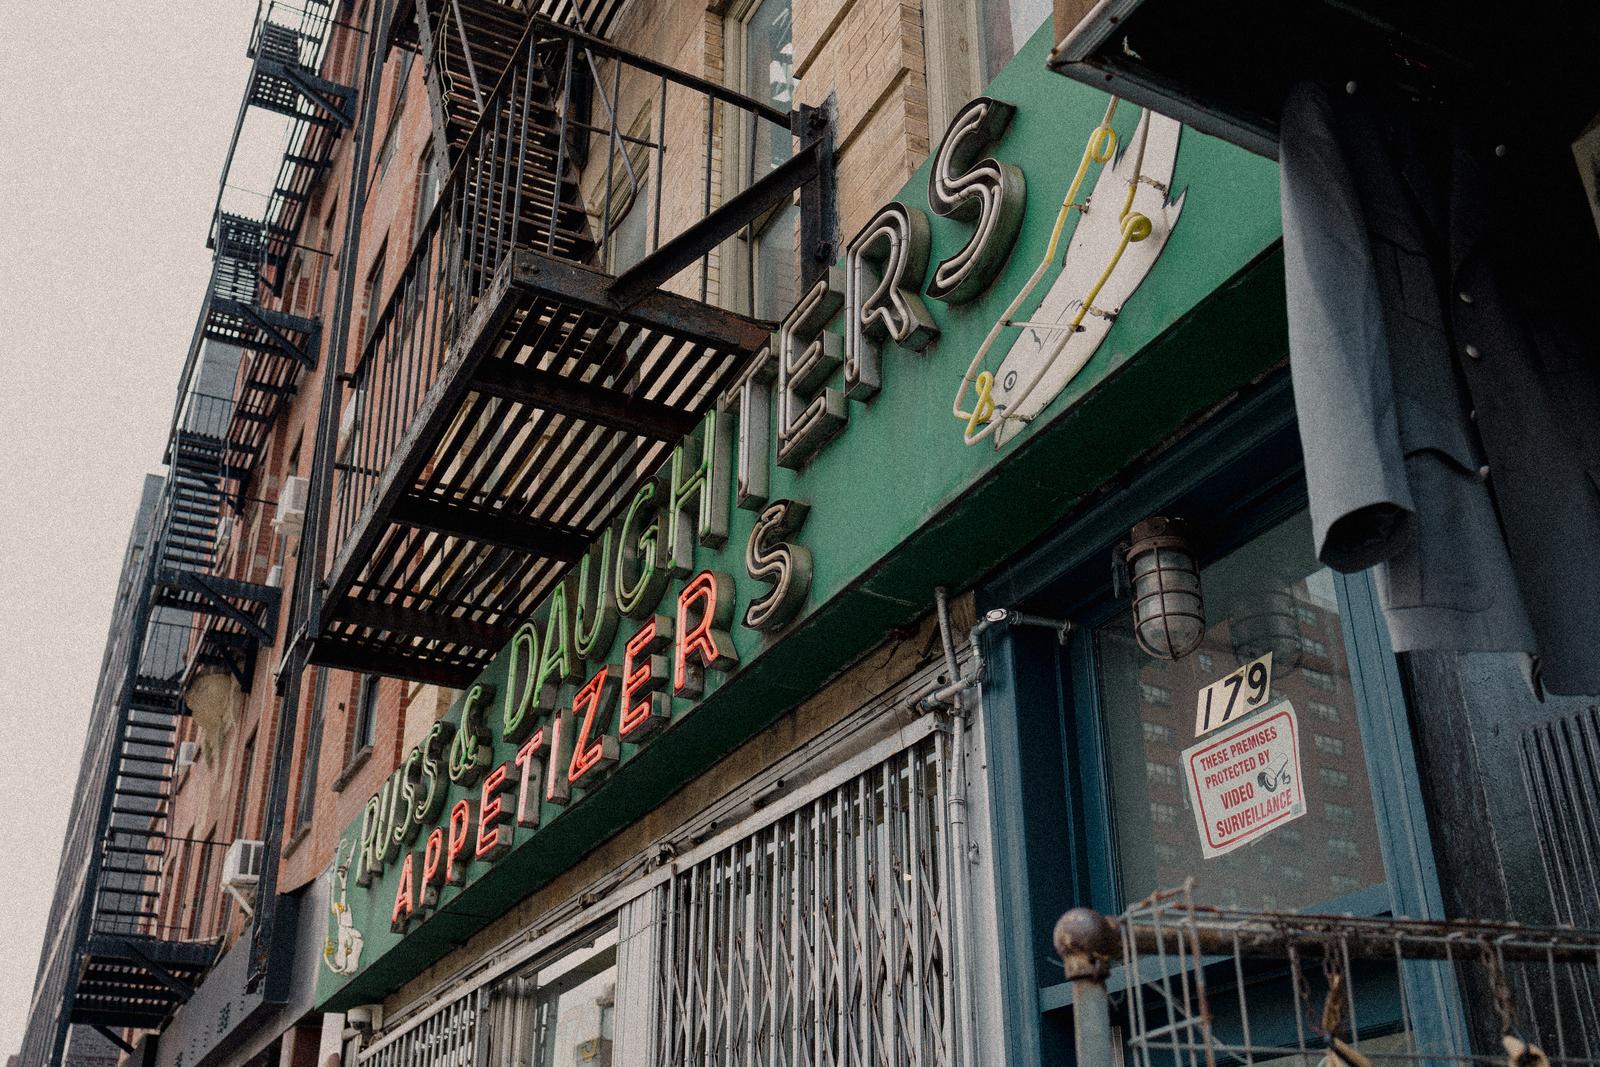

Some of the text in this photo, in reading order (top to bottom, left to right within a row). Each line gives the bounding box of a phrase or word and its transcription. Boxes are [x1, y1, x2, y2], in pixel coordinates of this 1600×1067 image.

[356, 96, 1027, 887] RUSS & DAUGHTERS
[391, 499, 813, 934] APPETIZERS
[1204, 662, 1268, 731] 179
[1200, 726, 1278, 771] THESE PREMISES
[1205, 749, 1270, 790] PROTECTED BY
[1216, 788, 1293, 837] SURVEILLANCE
[1220, 781, 1254, 811] VIDEO
